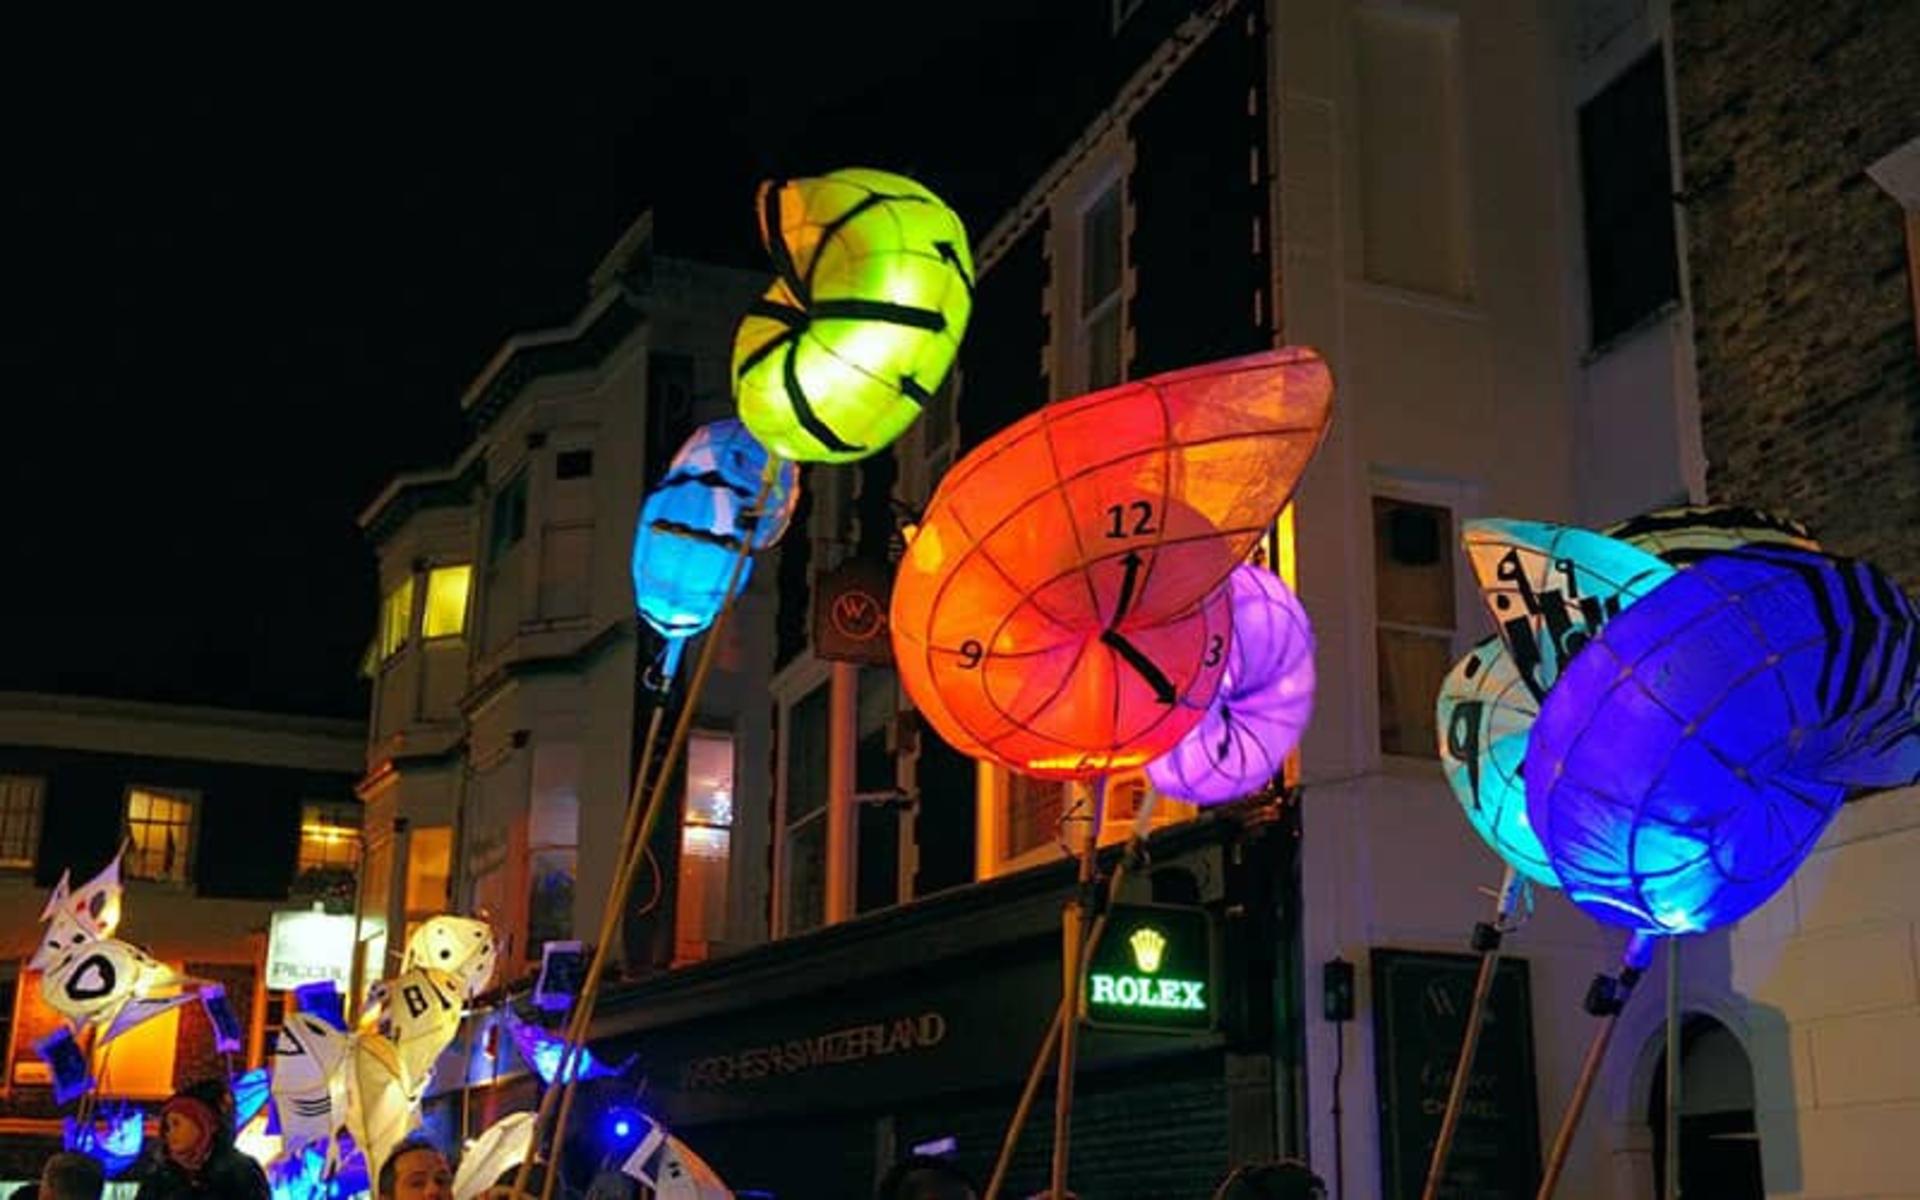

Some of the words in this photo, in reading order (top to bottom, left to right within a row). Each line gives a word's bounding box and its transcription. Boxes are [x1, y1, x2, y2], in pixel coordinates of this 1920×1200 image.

[1106, 502, 1156, 538] 12
[956, 639, 982, 669] 9
[1204, 635, 1224, 668] 3
[1091, 975, 1207, 1010] ROLEX
